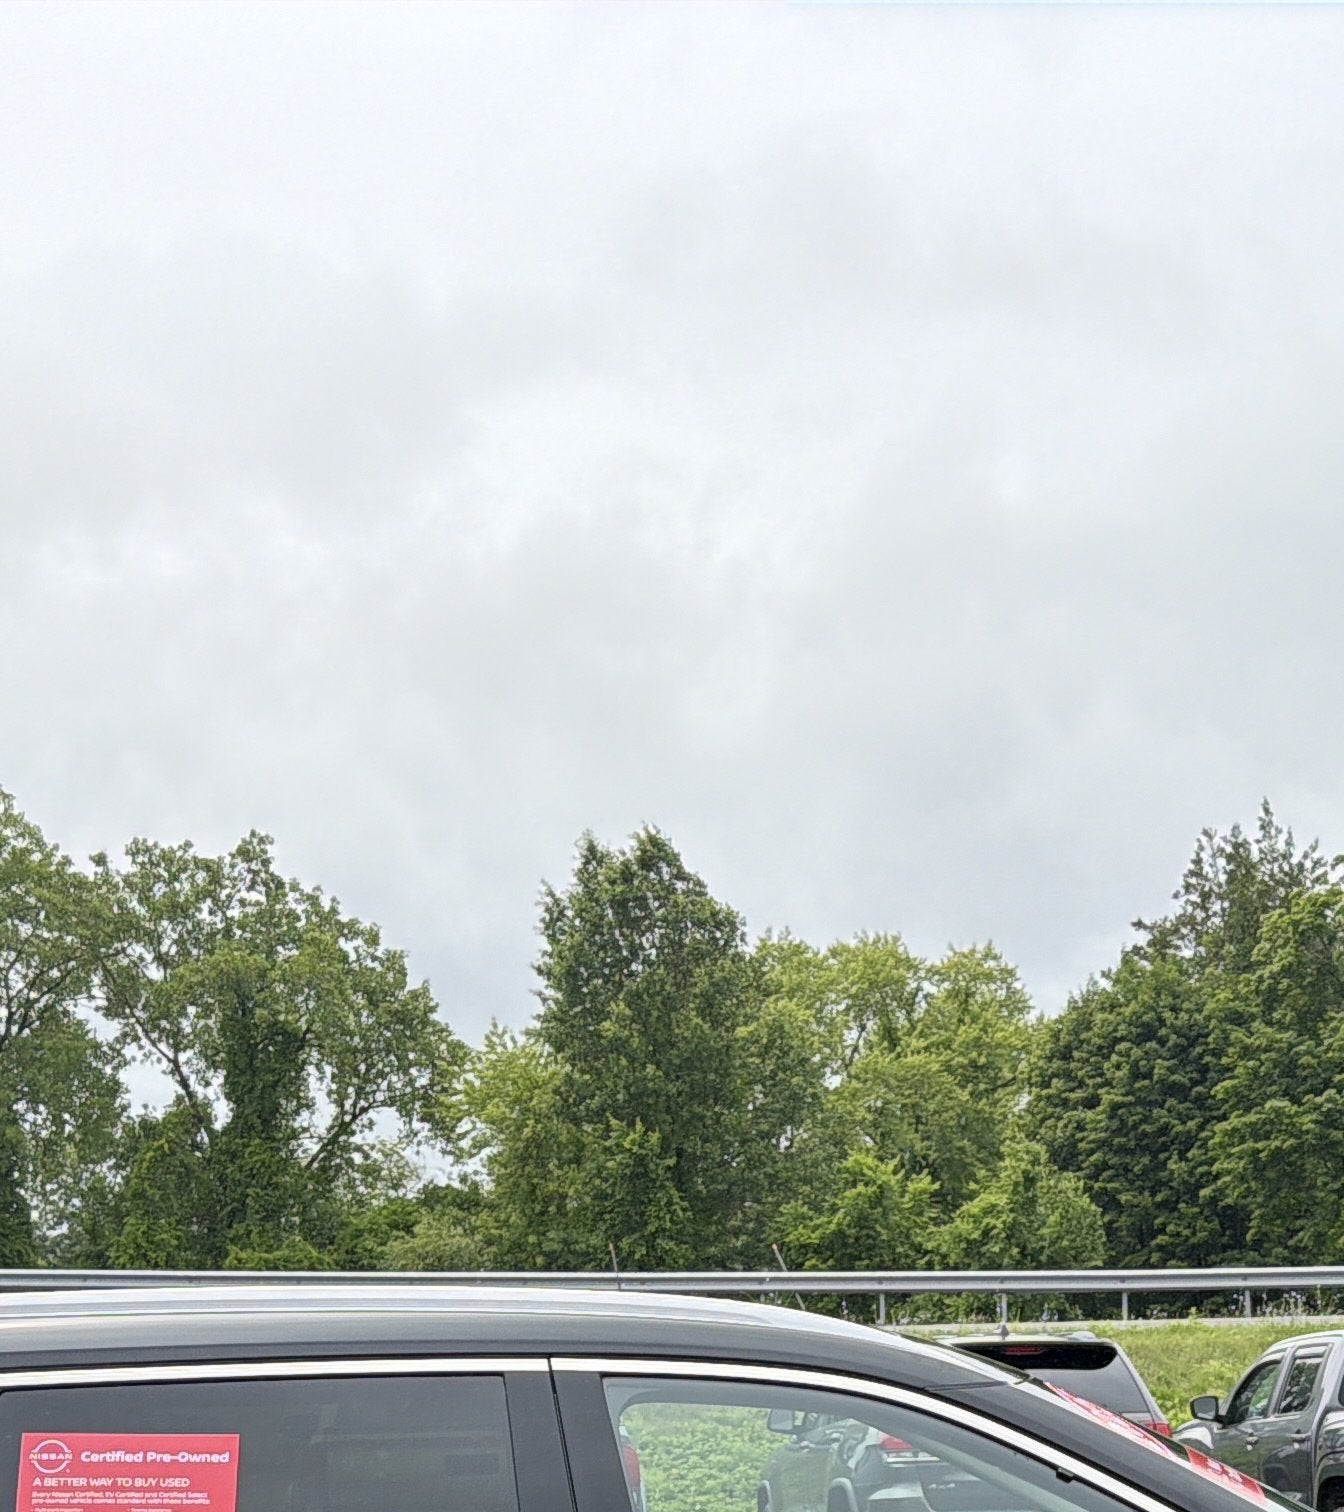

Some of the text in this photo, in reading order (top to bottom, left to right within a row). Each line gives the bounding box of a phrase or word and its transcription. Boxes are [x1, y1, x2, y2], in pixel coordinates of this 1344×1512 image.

[29, 1453, 73, 1461] NISSAN
[80, 1450, 230, 1463] Certified Pre-Owned
[32, 1477, 191, 1488] A BETTER WAY TO BUY USED
